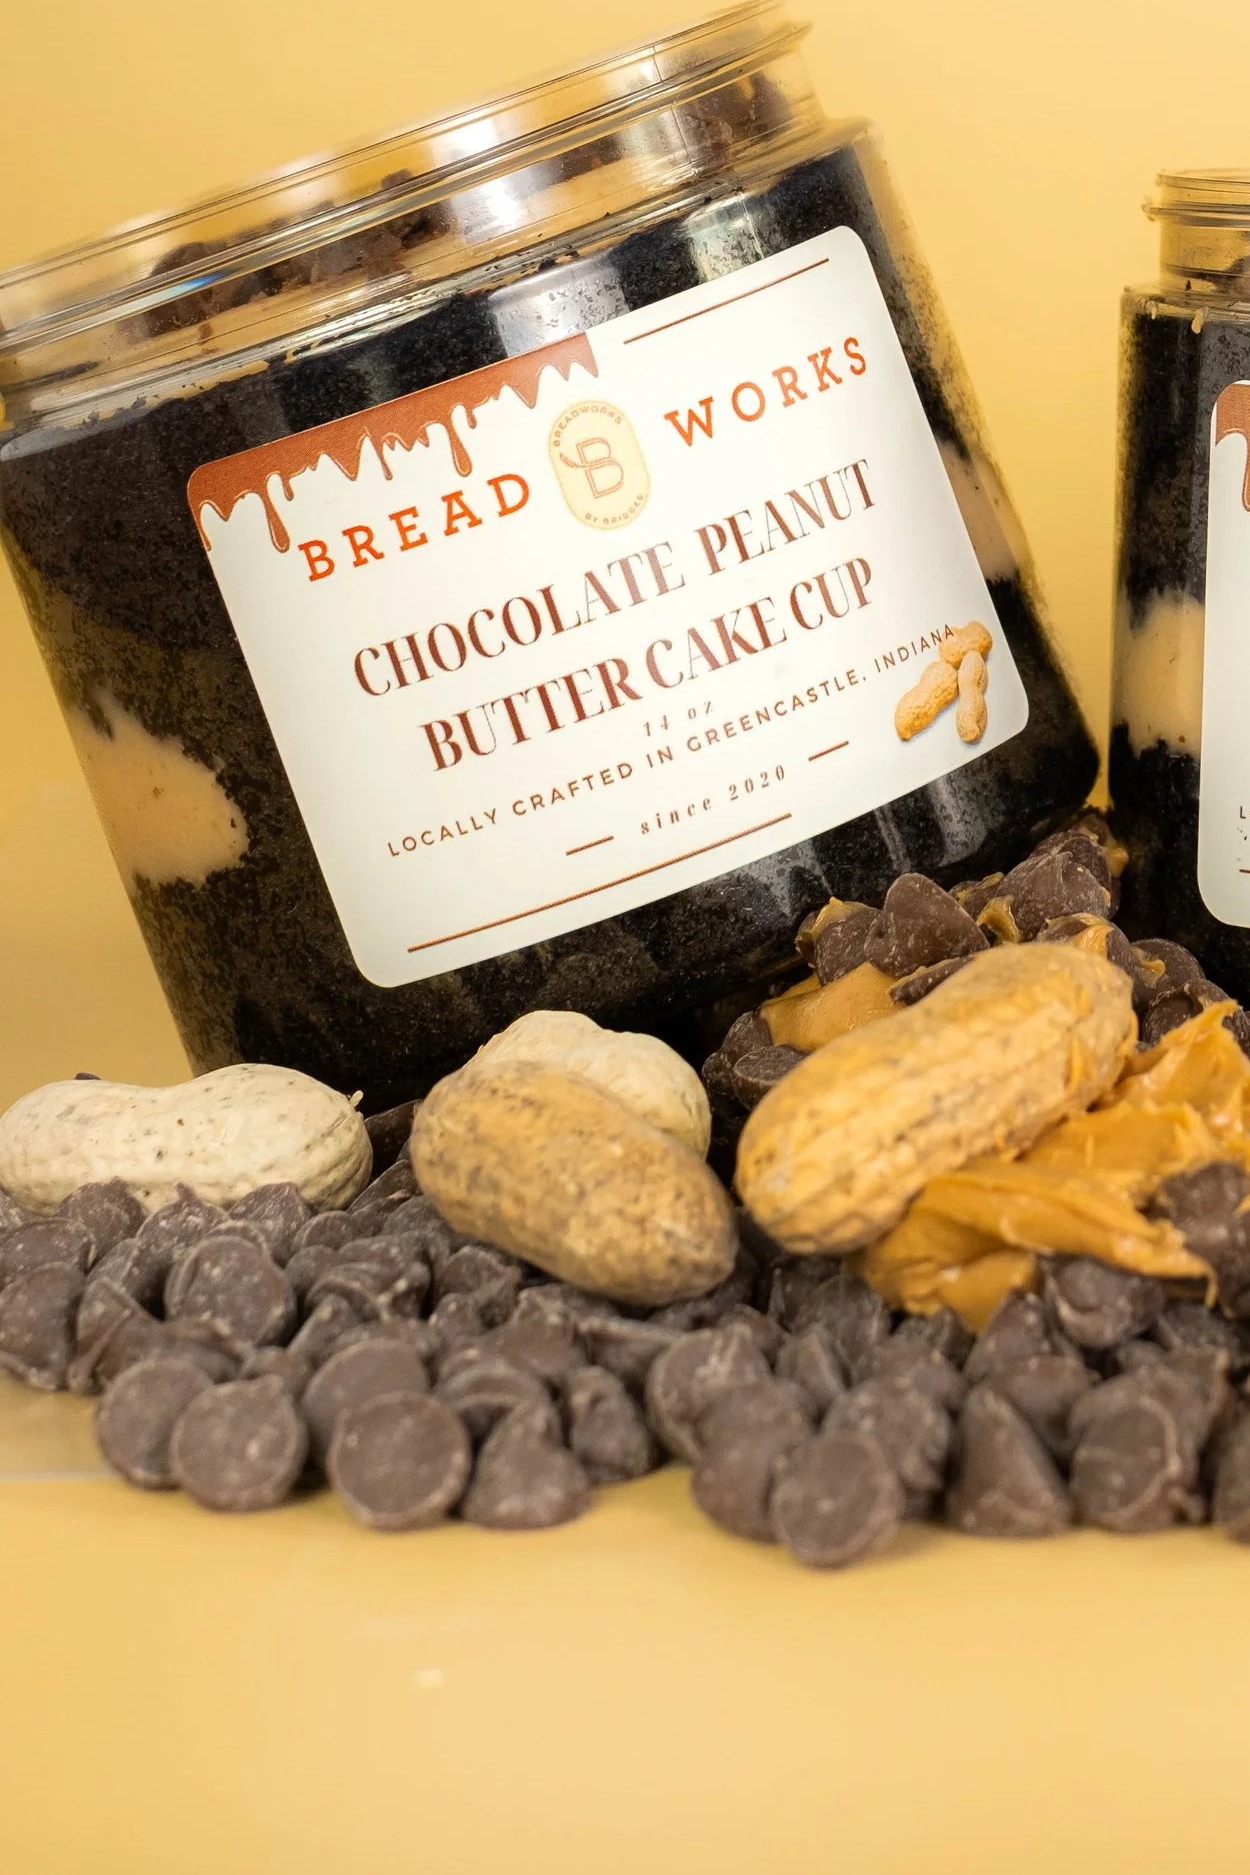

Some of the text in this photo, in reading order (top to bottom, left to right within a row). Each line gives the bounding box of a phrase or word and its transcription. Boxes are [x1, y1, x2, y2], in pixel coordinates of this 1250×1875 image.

[297, 335, 868, 583] BREAD WORKS
[353, 458, 878, 697] CHOCOLATE PEANUT
[418, 556, 874, 772] BUTTER CAKE CUP
[387, 623, 957, 858] LOCALLY CRAFTED IN GREENCASTLE, INDIANA
[640, 764, 786, 836] since 2020
[643, 699, 715, 738] 14 oz
